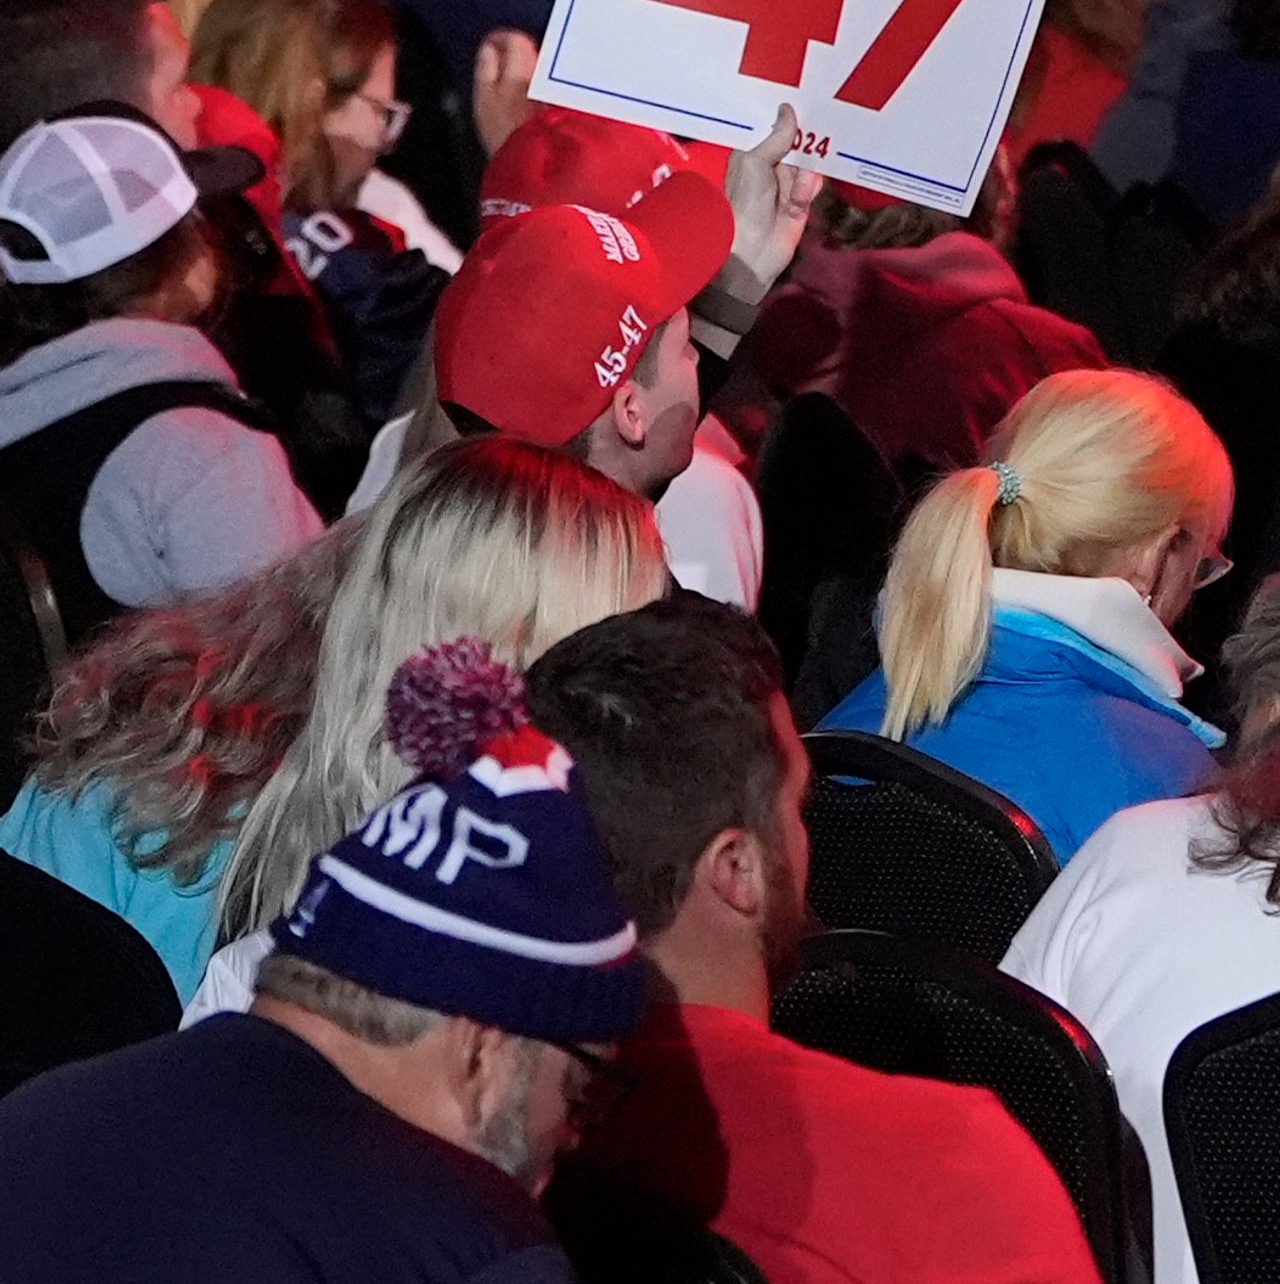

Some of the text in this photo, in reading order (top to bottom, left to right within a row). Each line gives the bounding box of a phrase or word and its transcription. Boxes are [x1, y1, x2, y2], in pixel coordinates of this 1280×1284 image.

[791, 127, 831, 158] 024
[284, 211, 353, 280] 20
[593, 304, 648, 388] 45-47
